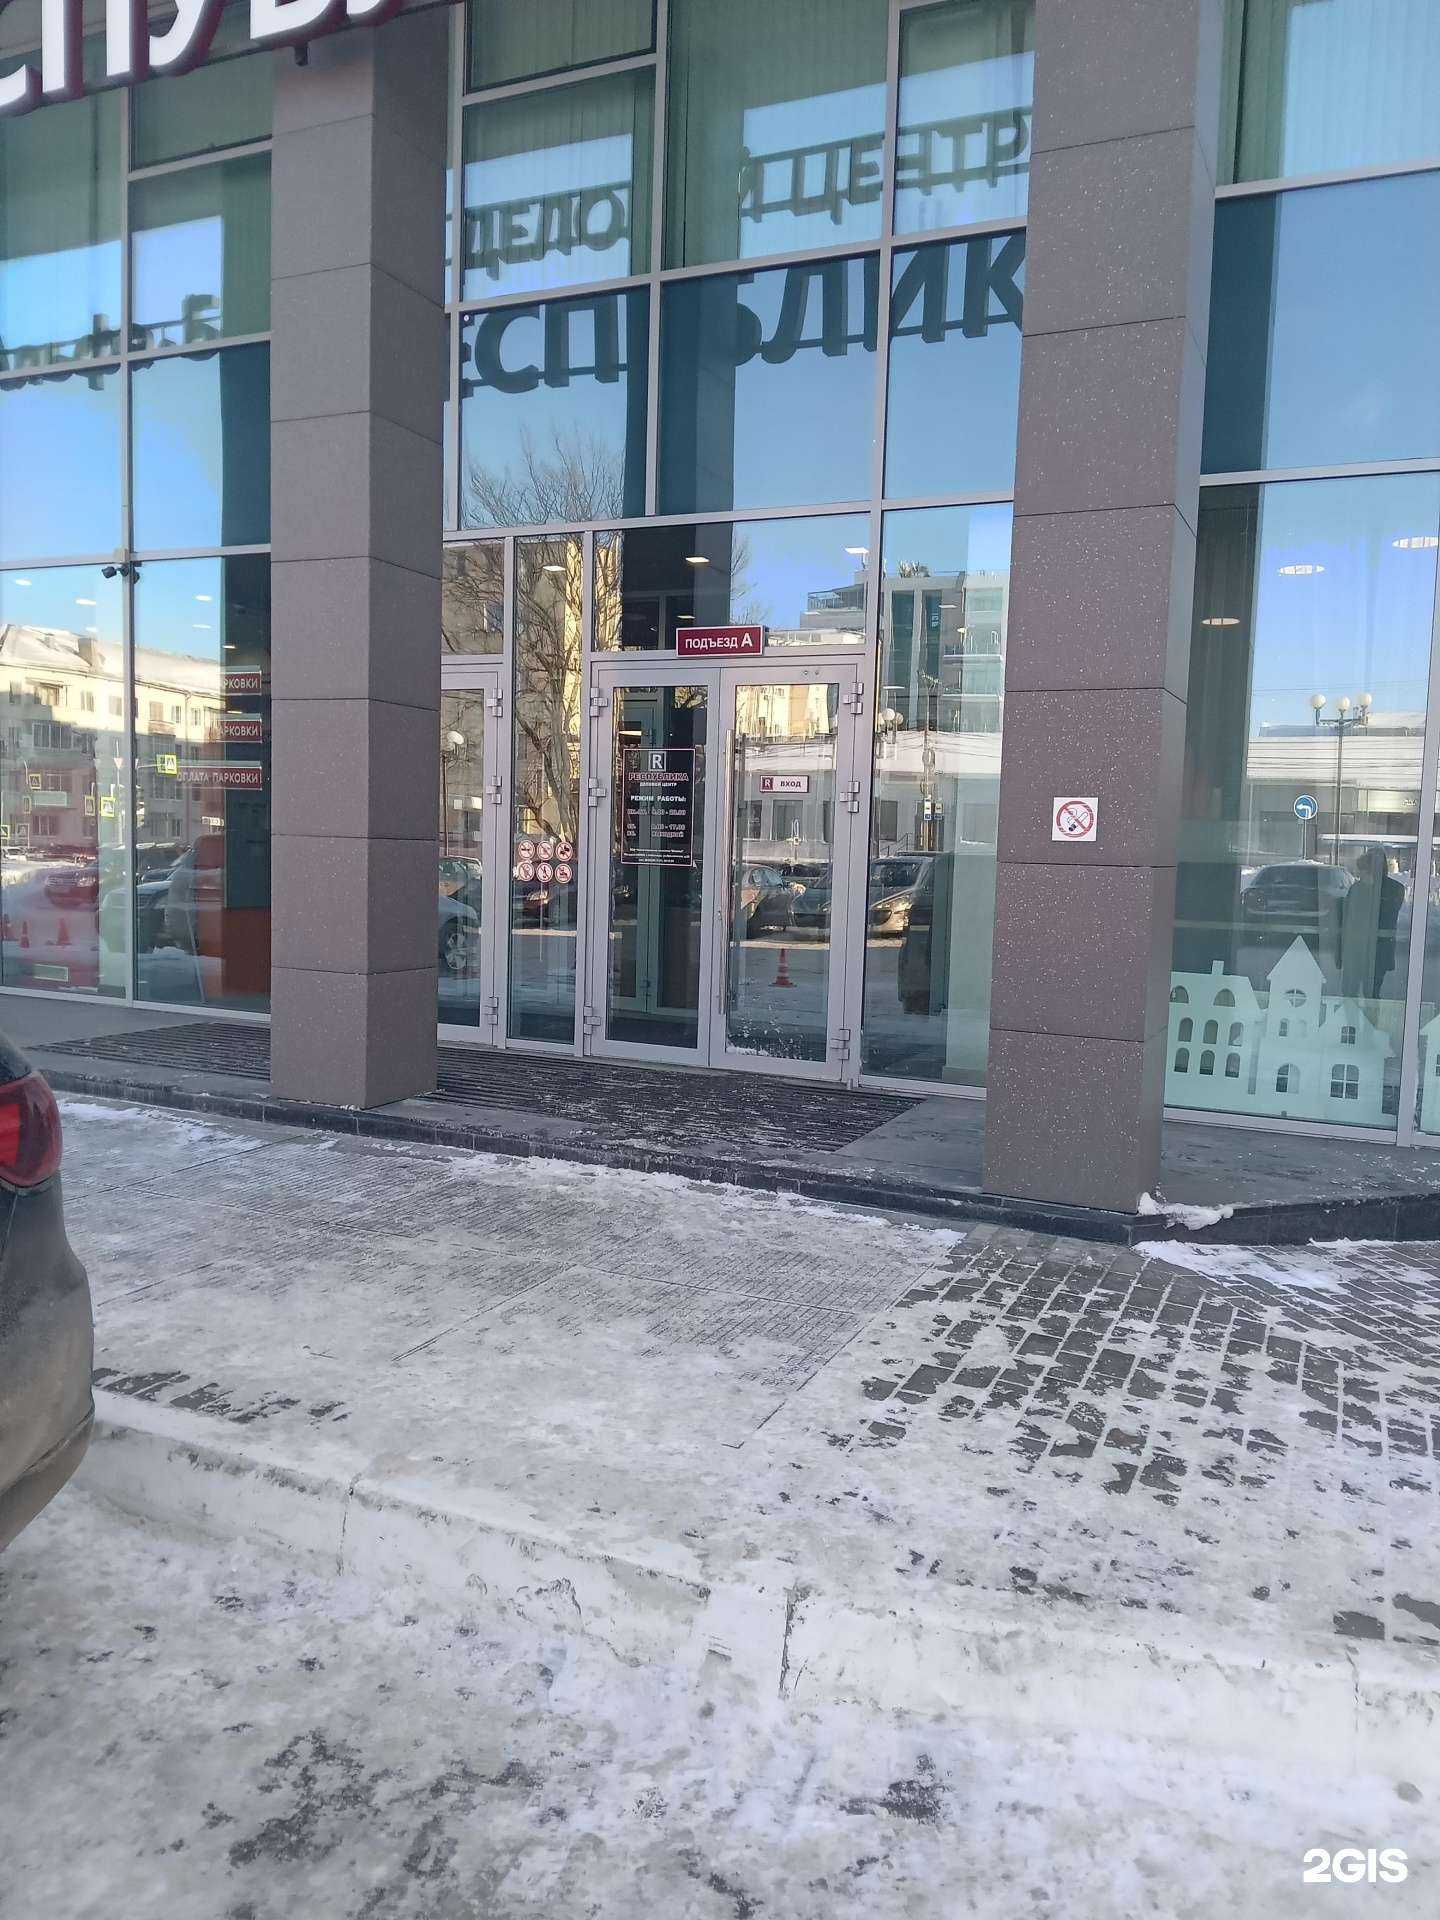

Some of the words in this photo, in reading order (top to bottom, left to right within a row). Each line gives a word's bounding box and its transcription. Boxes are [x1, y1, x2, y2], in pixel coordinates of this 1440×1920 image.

[685, 636, 738, 649] ПОДЪЕЗД
[212, 772, 258, 784] ПАРКОВКИ
[628, 772, 689, 783] РЕСПУБЛИКА
[780, 780, 802, 788] ВХОД
